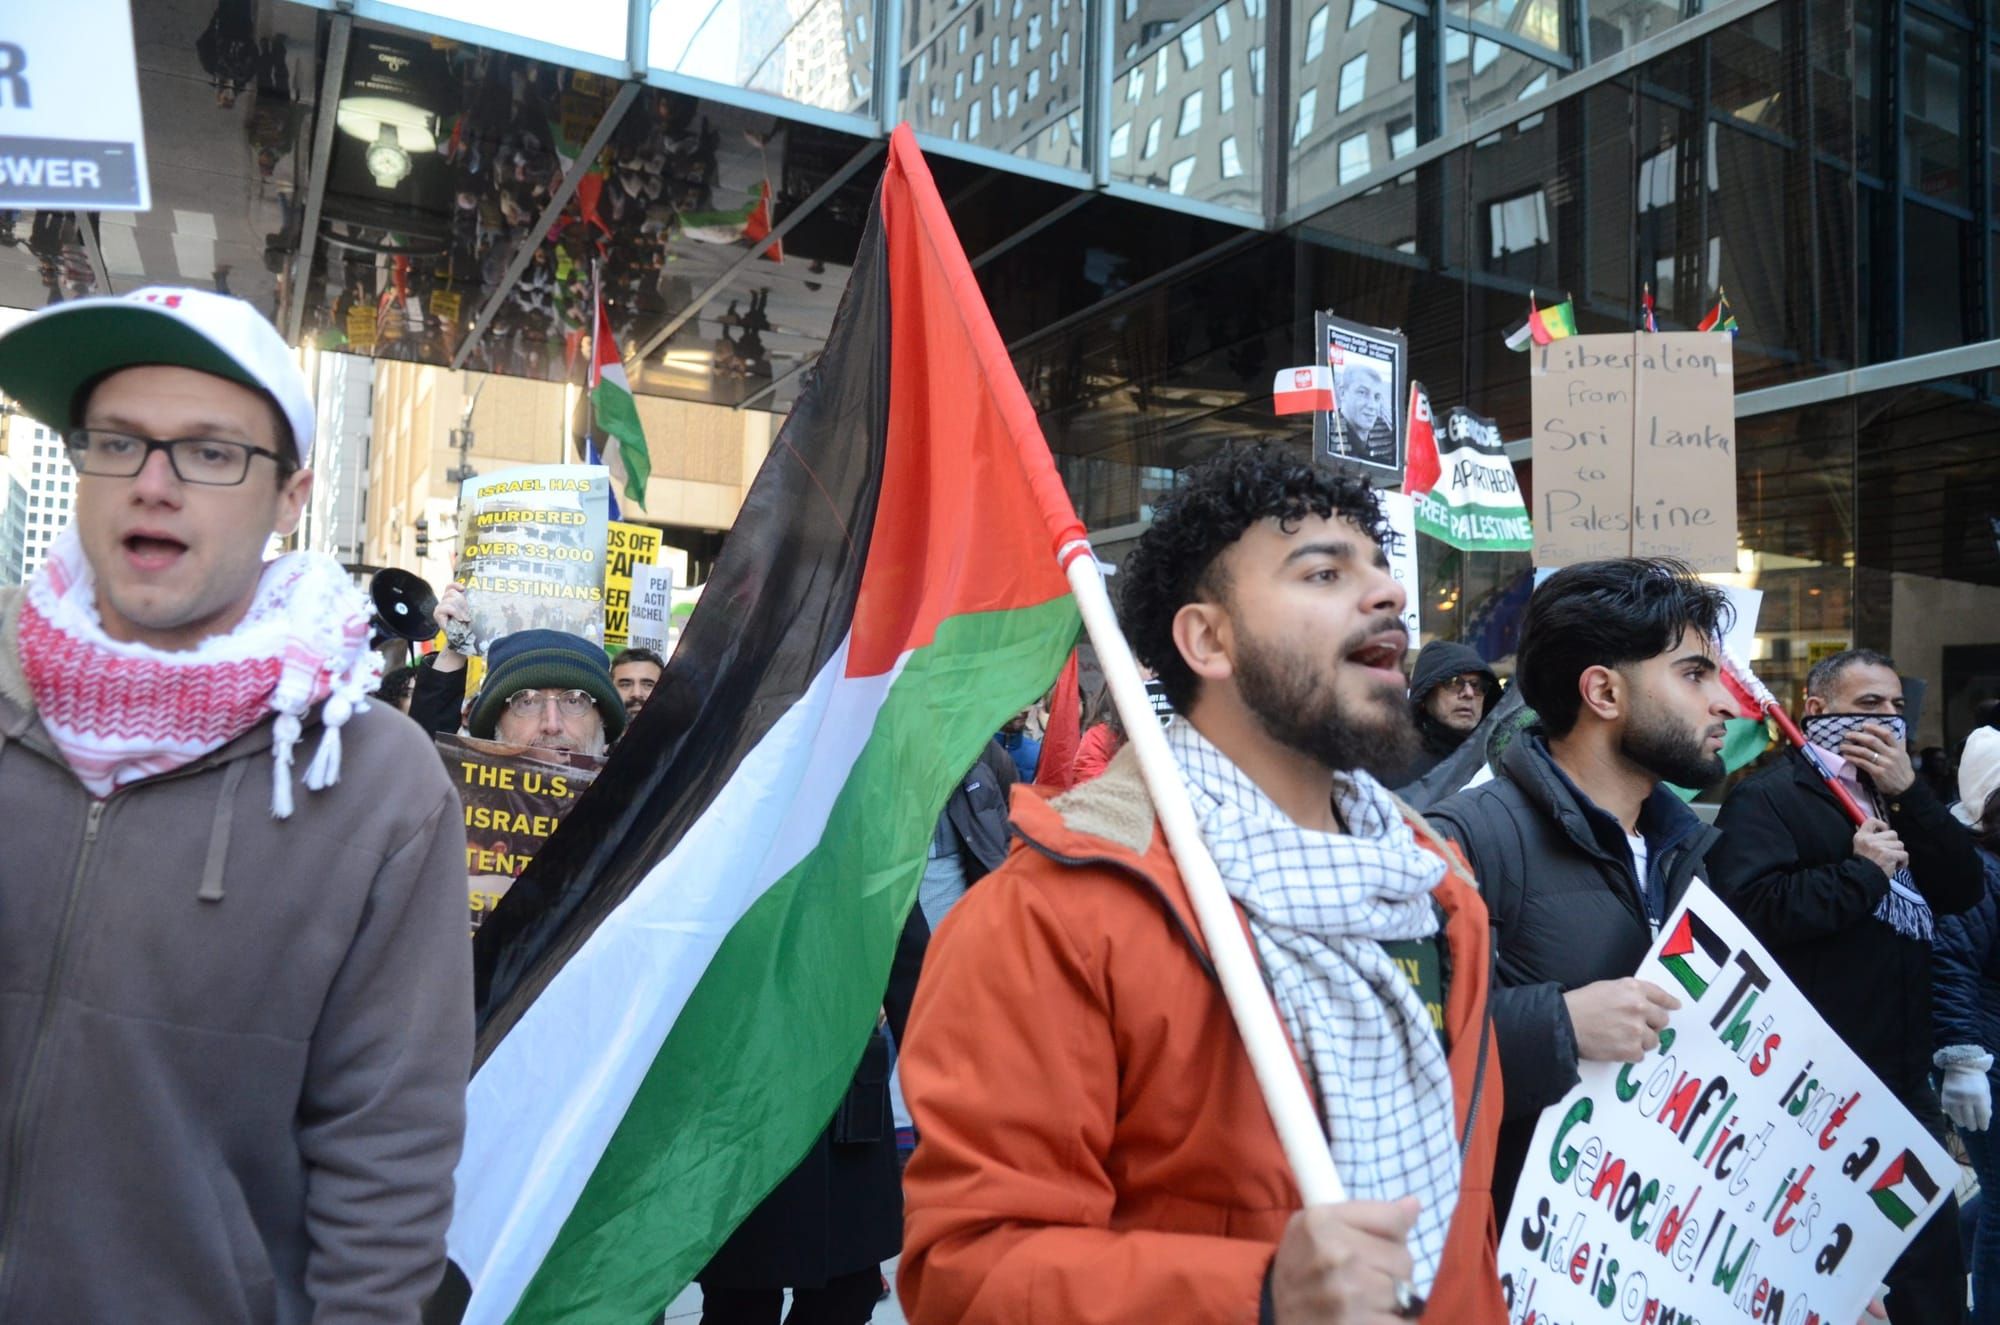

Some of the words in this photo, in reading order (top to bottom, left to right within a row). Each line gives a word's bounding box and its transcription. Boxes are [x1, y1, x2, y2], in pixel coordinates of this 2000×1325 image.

[1541, 343, 1718, 377] Liberation
[1568, 380, 1628, 406] from
[1543, 418, 1609, 451] Sri
[1650, 415, 1730, 456] Lanka
[477, 478, 545, 499] ISRAEL
[549, 478, 591, 493] HAS
[1575, 464, 1607, 482] to
[477, 511, 587, 527] MURDERED
[1411, 490, 1449, 527] FREE
[1450, 512, 1533, 541] PALESTINE
[1544, 489, 1718, 533] Palestine
[465, 543, 520, 559] OVER
[523, 542, 595, 563] 33,000
[629, 533, 656, 553] OFF
[631, 605, 663, 621] RACHEL
[461, 762, 516, 790] THE
[523, 772, 575, 799] U.S.
[1709, 949, 1781, 1077] This
[1842, 1137, 1880, 1182] a
[1550, 1097, 1726, 1283] Genocide!
[1711, 1223, 1785, 1325] When
[1815, 1223, 1853, 1275] a
[1590, 1243, 1619, 1309] is
